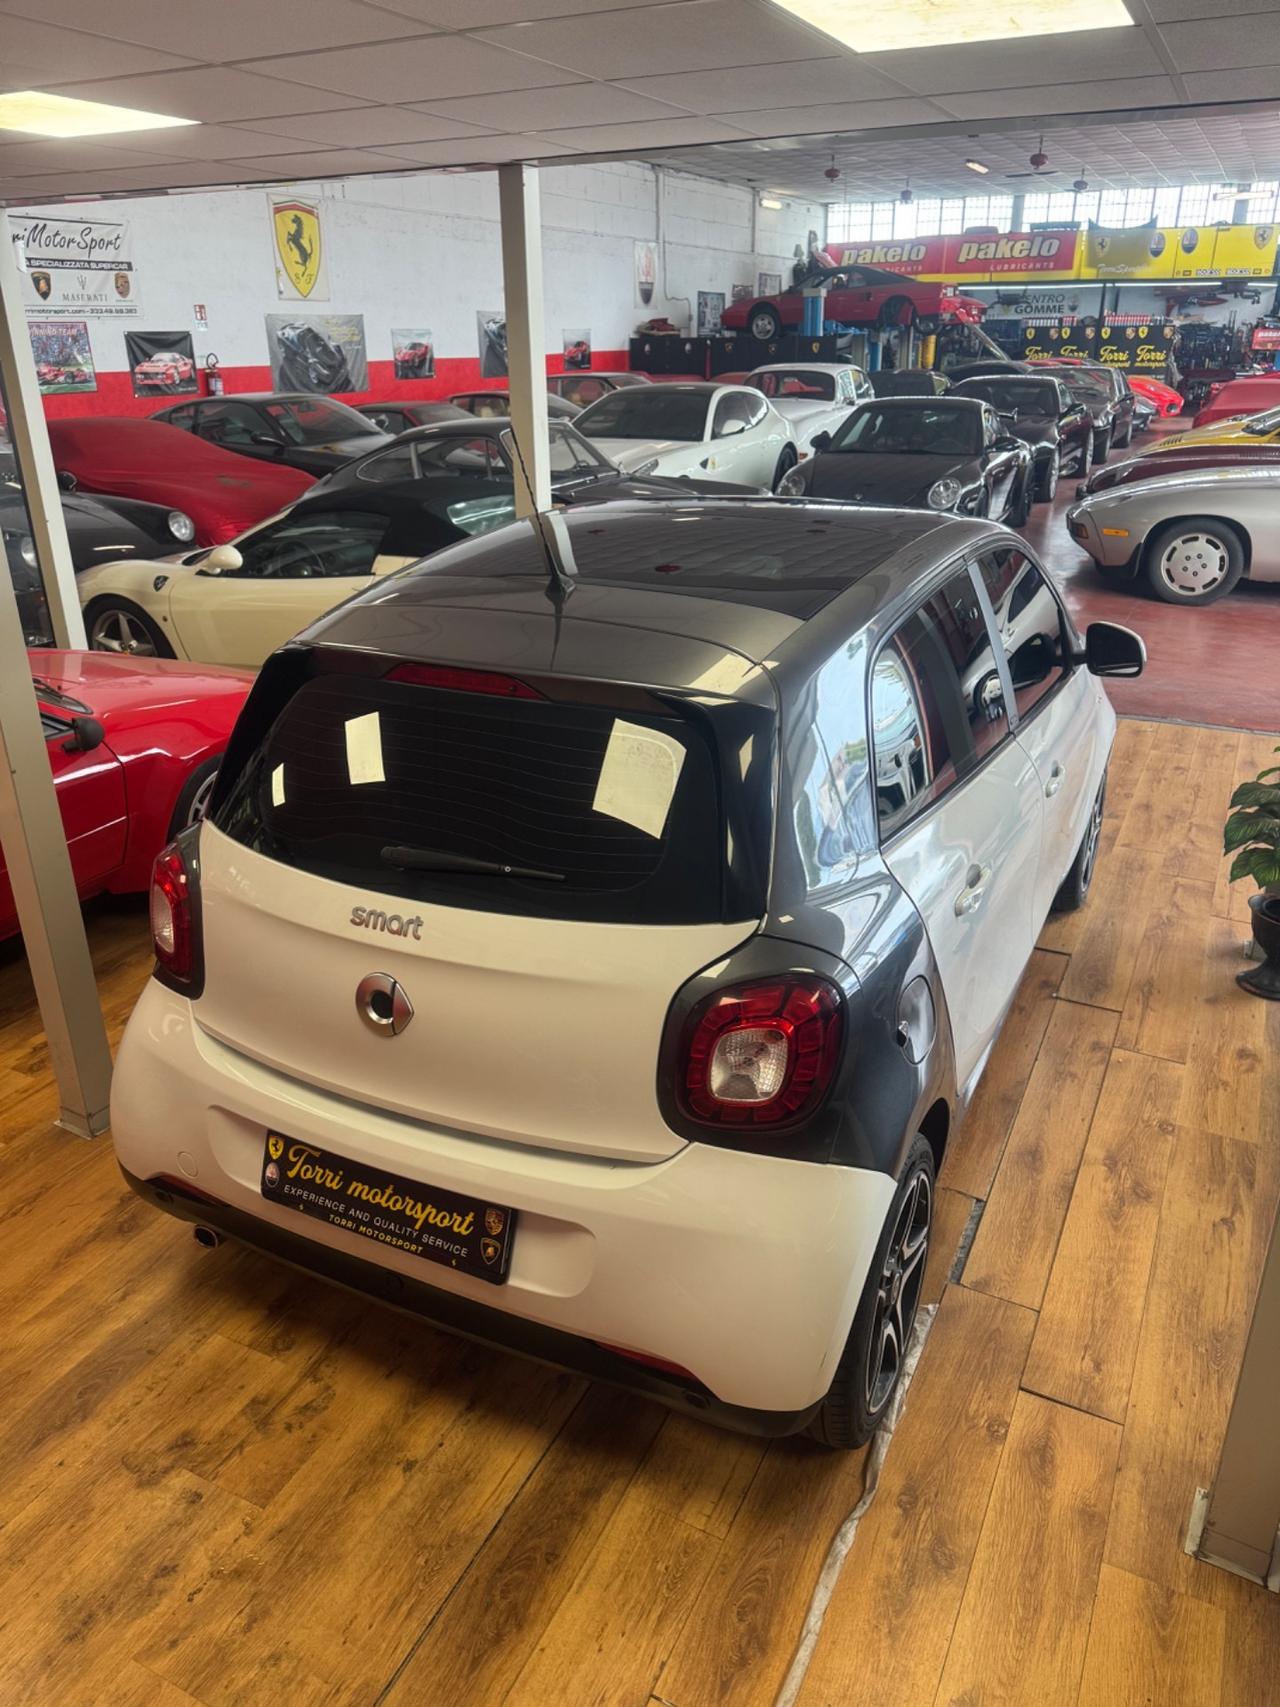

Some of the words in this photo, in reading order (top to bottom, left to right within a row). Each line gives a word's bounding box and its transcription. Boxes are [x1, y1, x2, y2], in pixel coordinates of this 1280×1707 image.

[841, 243, 927, 266] pakelo
[957, 236, 1060, 263] pakelo
[990, 262, 1055, 271] LUBRICANTS
[62, 293, 108, 302] MASERATI
[1014, 304, 1065, 315] GOMME
[1100, 345, 1129, 361] Torri
[1136, 345, 1167, 361] Torri
[350, 906, 424, 940] smart
[287, 1144, 344, 1190] Torri
[346, 1184, 475, 1237] motorsport
[283, 1184, 346, 1214] EXPERIENCE
[348, 1207, 370, 1223] AND
[373, 1215, 418, 1240] QUALITY
[421, 1233, 469, 1258] SERVICE
[329, 1213, 357, 1231] TORRI
[358, 1225, 424, 1255] MOTORSPORT
